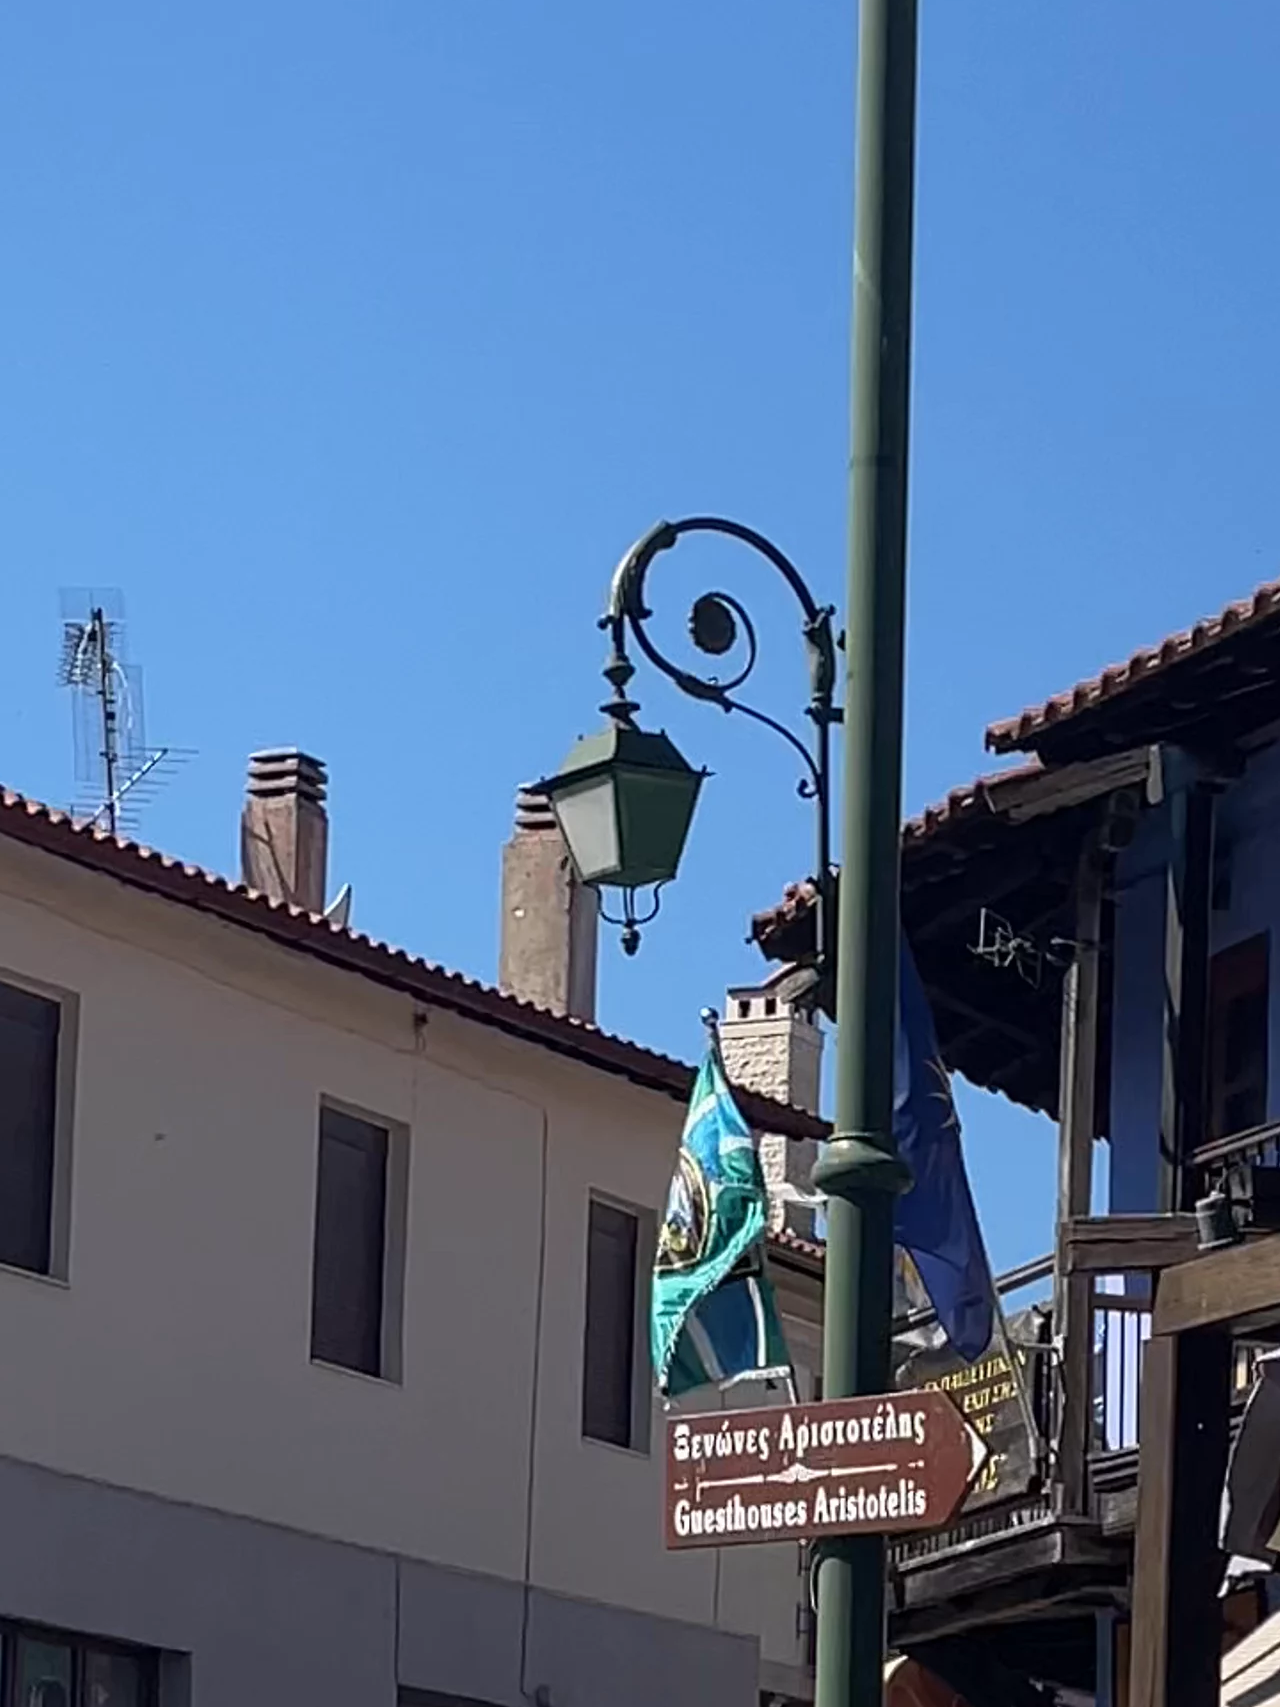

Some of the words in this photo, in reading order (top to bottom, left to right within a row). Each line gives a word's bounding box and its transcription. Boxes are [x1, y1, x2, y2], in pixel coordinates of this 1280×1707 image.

[673, 1420, 770, 1461] Ξενώνες
[777, 1403, 926, 1458] Αριστοτέλης
[673, 1495, 807, 1537] Guesthouses
[812, 1478, 926, 1525] Aristotelis
